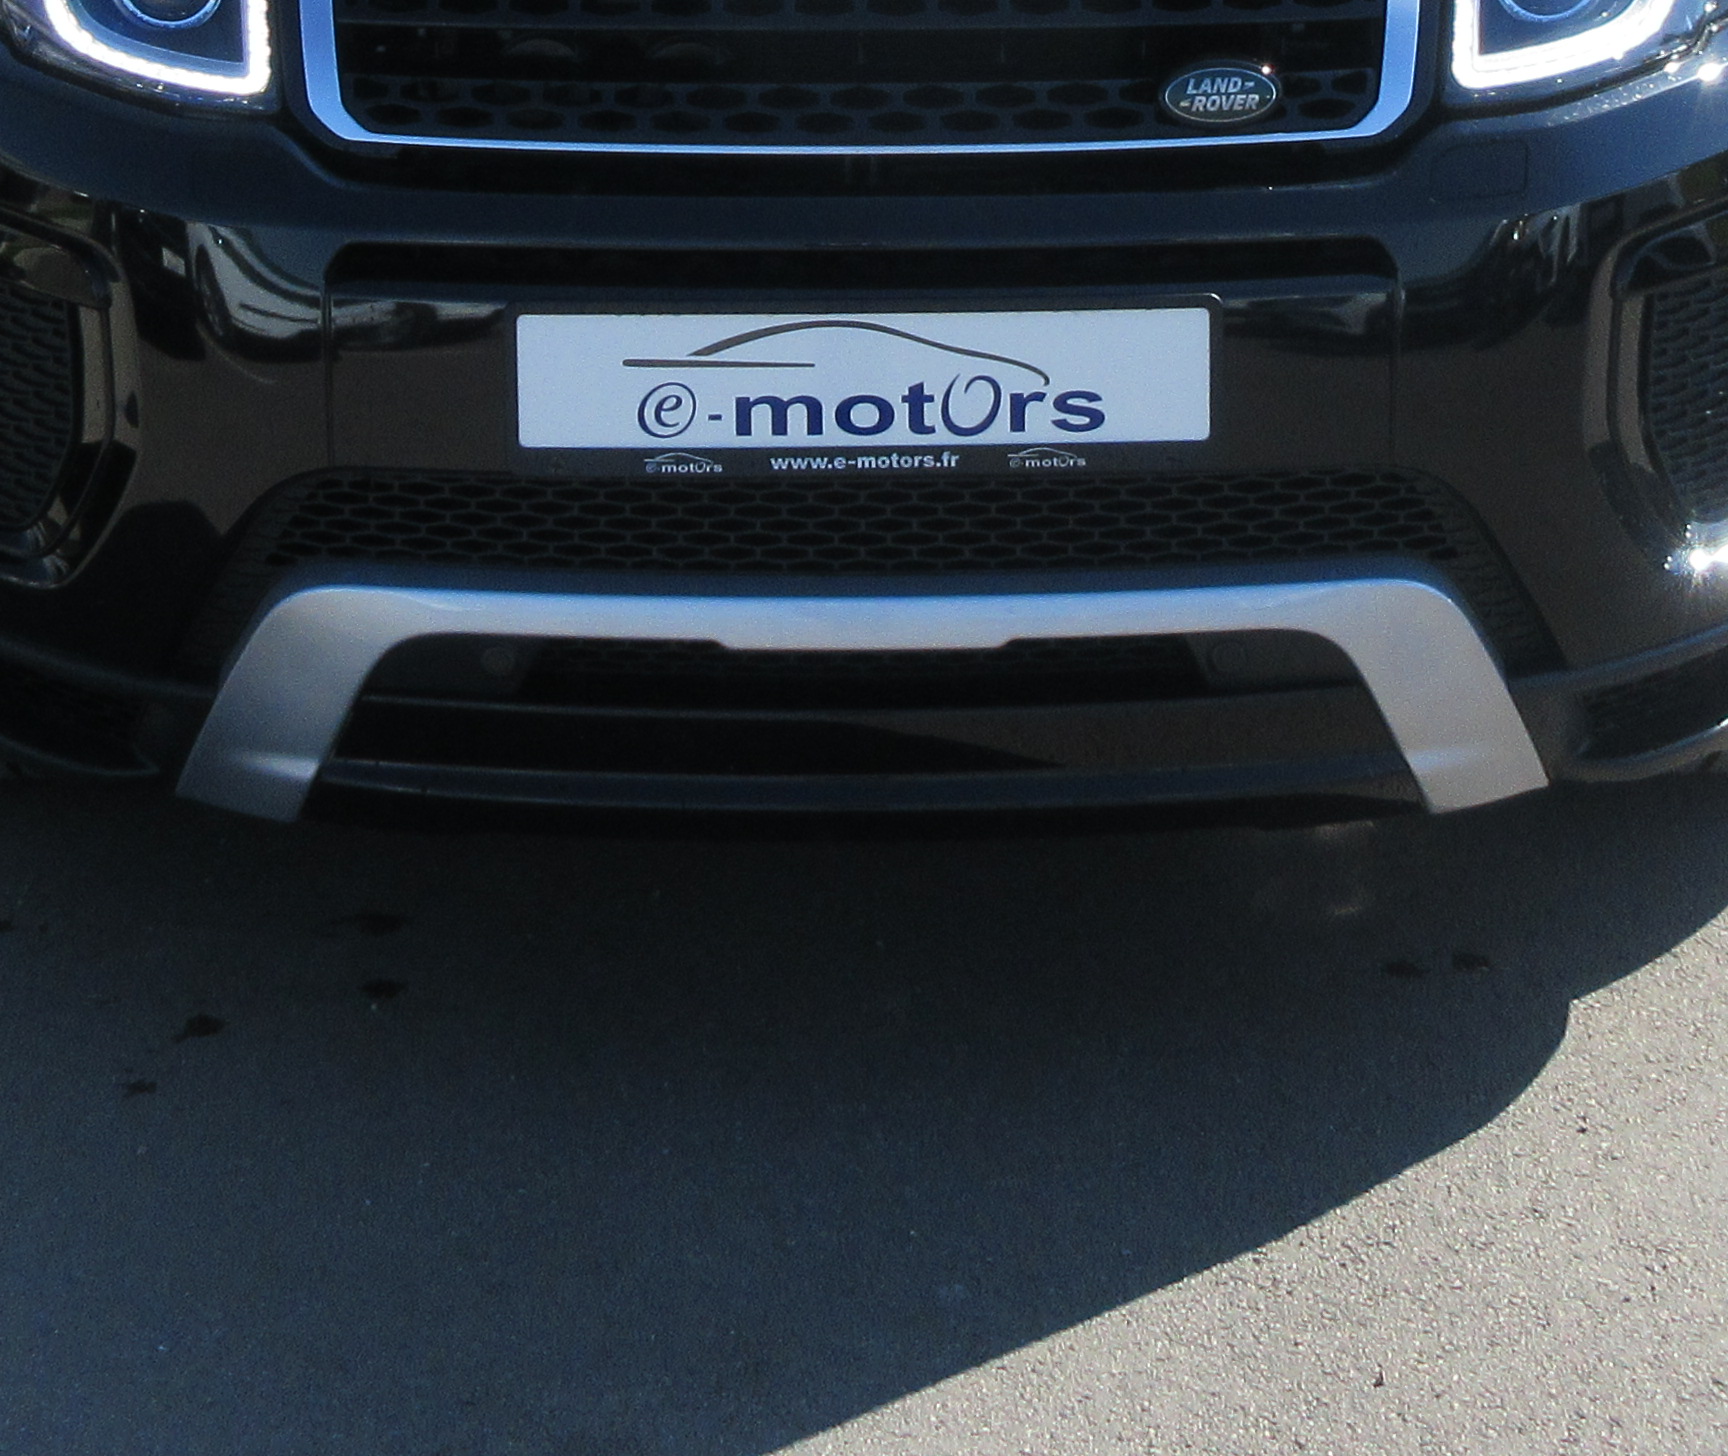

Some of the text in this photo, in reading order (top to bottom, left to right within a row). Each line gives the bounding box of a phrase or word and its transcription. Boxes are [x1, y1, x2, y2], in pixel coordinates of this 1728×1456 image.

[1186, 77, 1243, 95] LAND
[1191, 94, 1260, 112] ROVER
[770, 450, 960, 471] www.e-motors.fr
